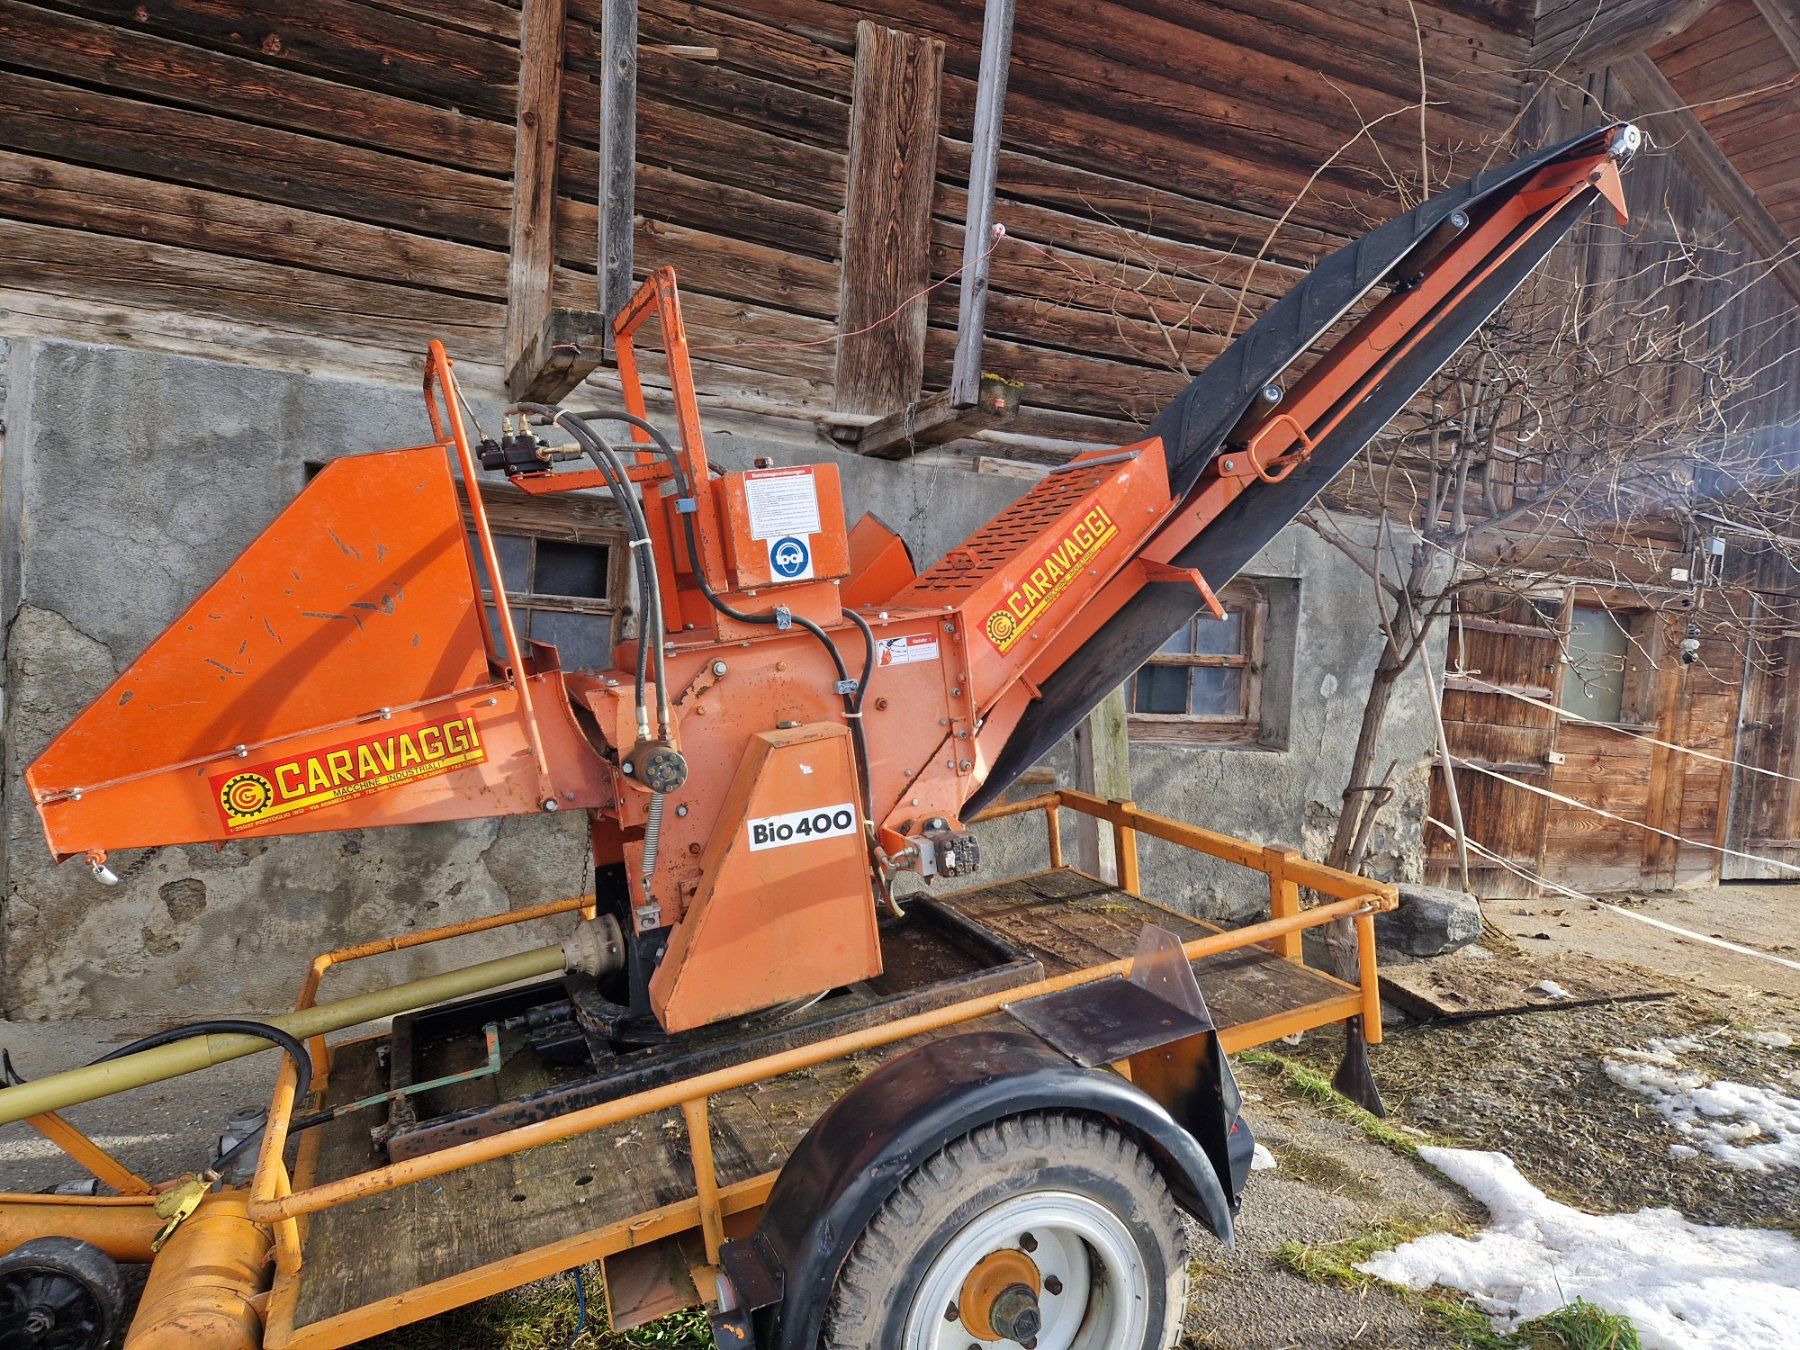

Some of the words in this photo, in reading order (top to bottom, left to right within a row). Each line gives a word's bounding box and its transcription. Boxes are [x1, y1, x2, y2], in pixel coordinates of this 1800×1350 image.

[1006, 504, 1112, 619] CARAVAGGI
[274, 715, 481, 800] CARAVAGGI
[333, 779, 381, 797] MACCHINE
[386, 761, 441, 782] INDUSTRIALI
